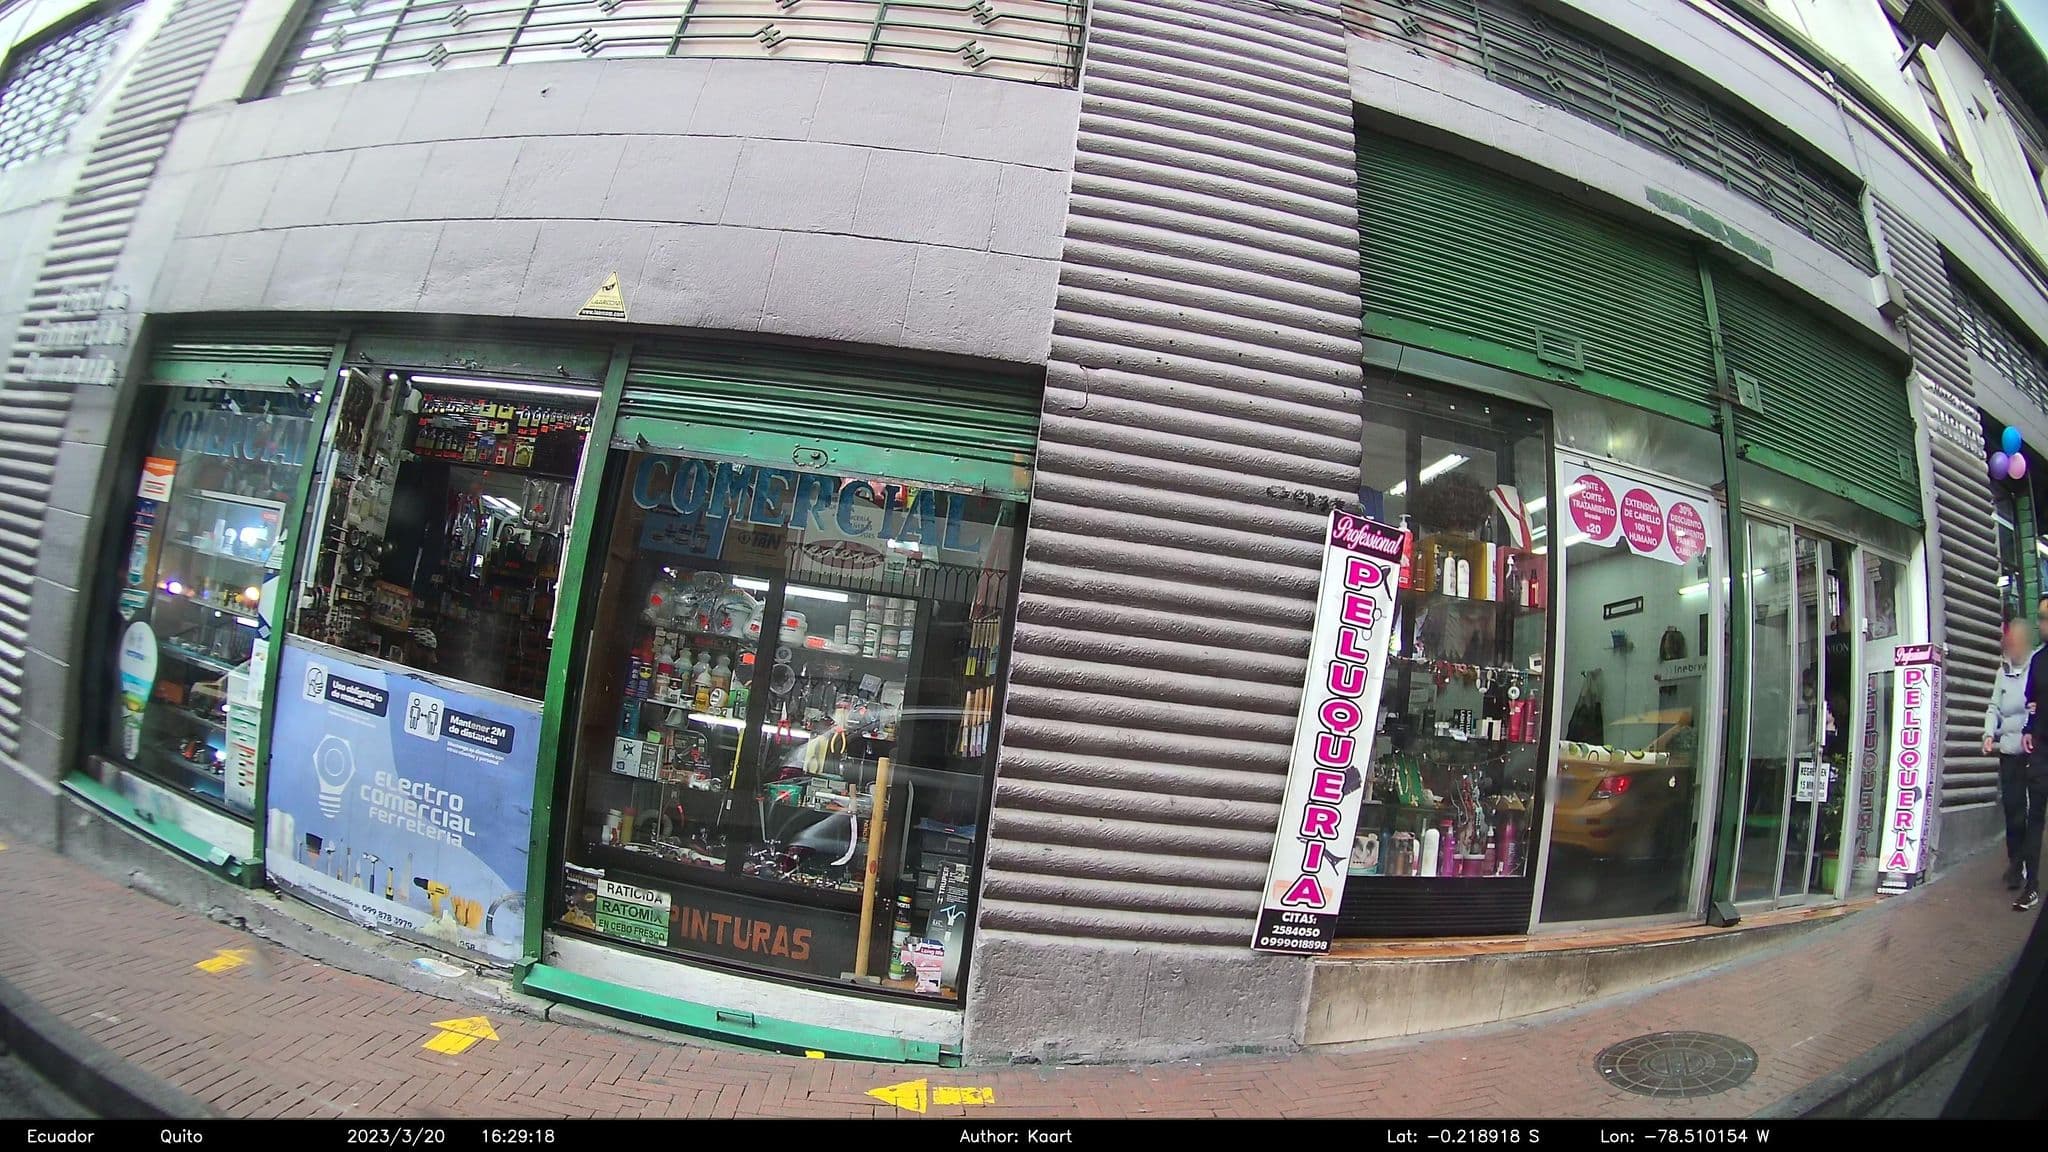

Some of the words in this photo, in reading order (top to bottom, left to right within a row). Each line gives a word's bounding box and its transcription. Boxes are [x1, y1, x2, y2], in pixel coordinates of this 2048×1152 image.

[632, 456, 981, 553] COMERCIAL
[1572, 499, 1615, 517] TRATAMIENTO
[1624, 508, 1633, 517] DE
[1633, 511, 1661, 525] CABELLO
[1670, 513, 1702, 530] DESCUENTO
[1333, 515, 1402, 555] Professional
[1629, 531, 1658, 546] HUMANO
[331, 690, 340, 699] de
[332, 680, 346, 691] Uso
[346, 684, 383, 703] obligatorio
[448, 725, 459, 735] de
[460, 728, 498, 745] distancia
[450, 715, 490, 733] Mantener
[490, 727, 506, 738] 2M
[1283, 556, 1382, 908] PELUQUERIA
[1887, 668, 1924, 870] PELUQUERIA
[607, 882, 663, 904] RATICIDA
[602, 900, 663, 924] RATOMIX
[1282, 912, 1317, 924] CITAS:
[599, 919, 609, 929] EN
[634, 926, 665, 941] FRESCO
[1272, 925, 1320, 937] 2584050
